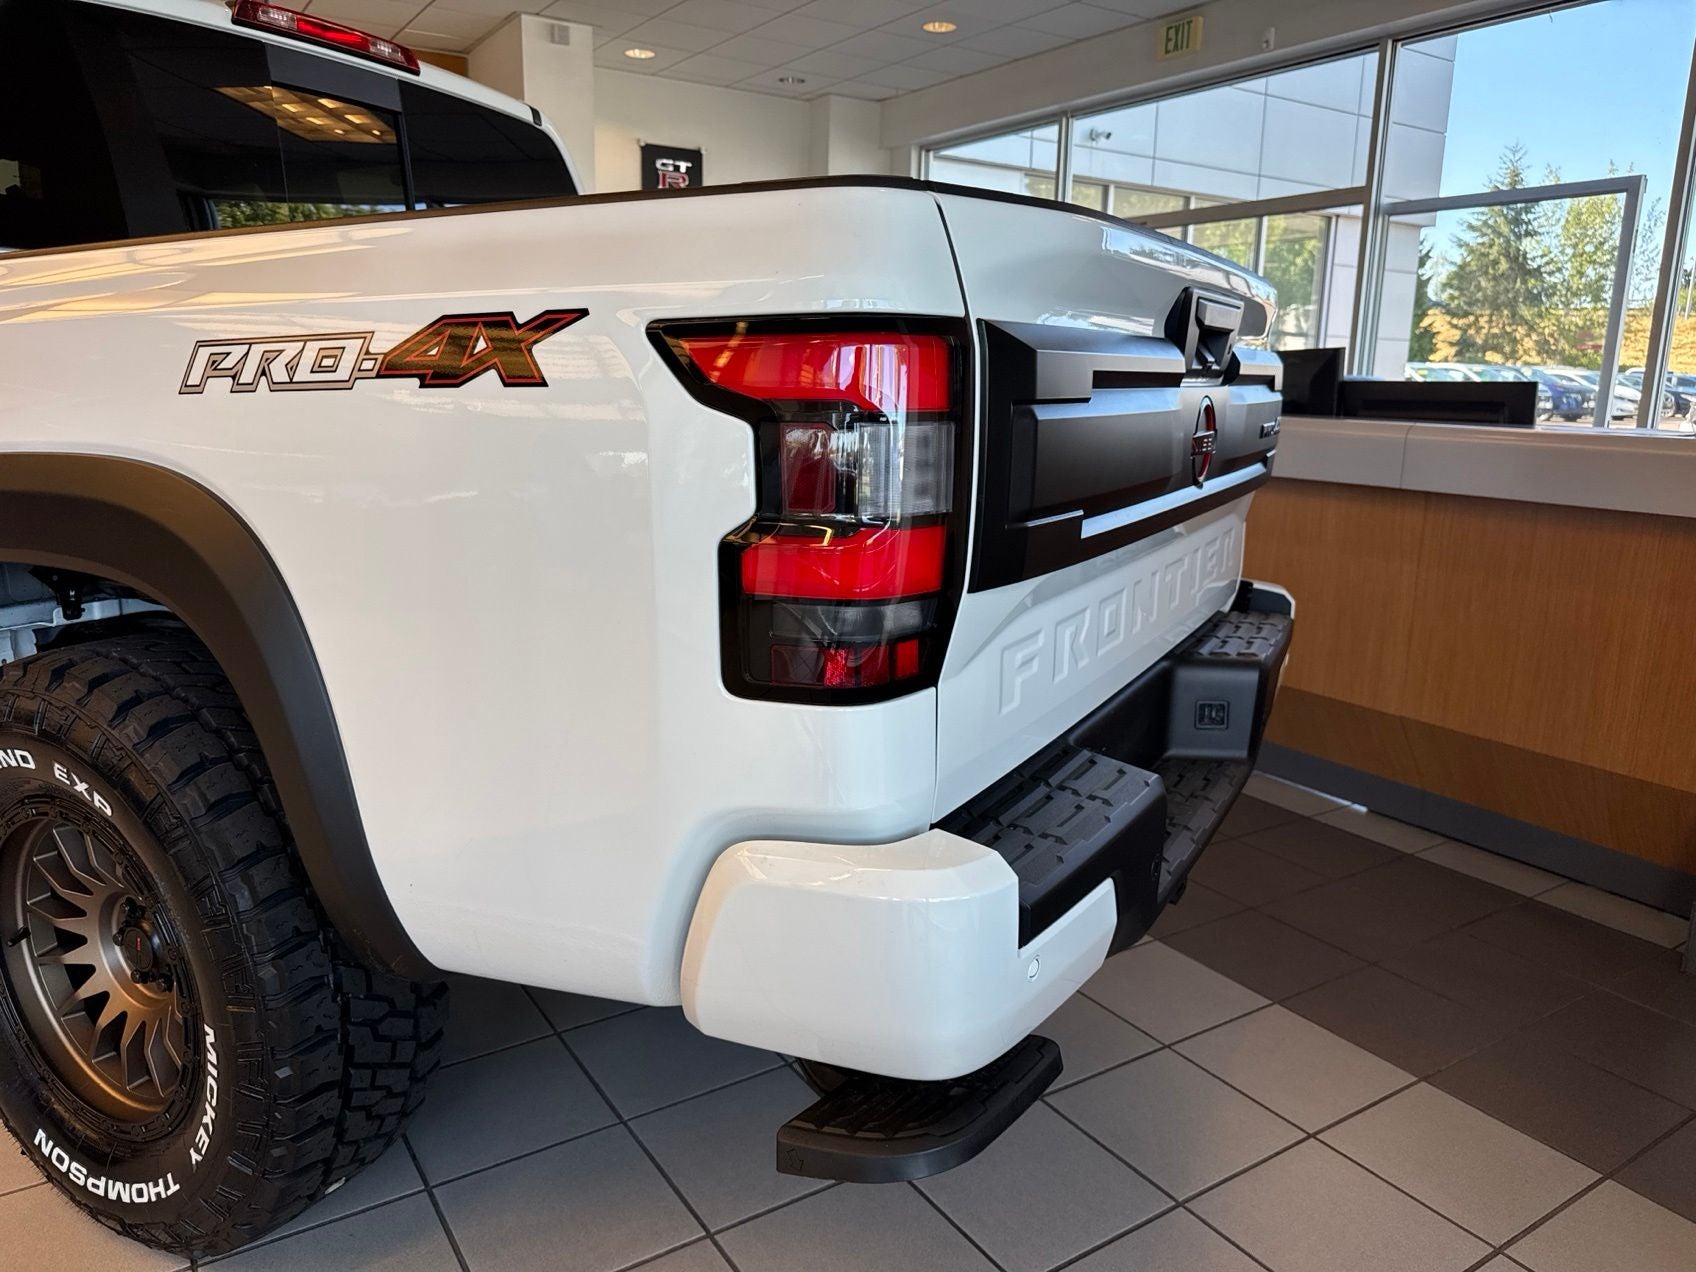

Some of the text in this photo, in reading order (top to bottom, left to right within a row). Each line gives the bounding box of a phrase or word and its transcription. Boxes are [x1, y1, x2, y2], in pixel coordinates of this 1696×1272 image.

[1164, 20, 1192, 54] EXIT
[655, 158, 692, 173] GT
[657, 171, 689, 189] R
[0, 749, 113, 817] ND EXP
[33, 1023, 219, 1204] MICKEY THOMPSON
